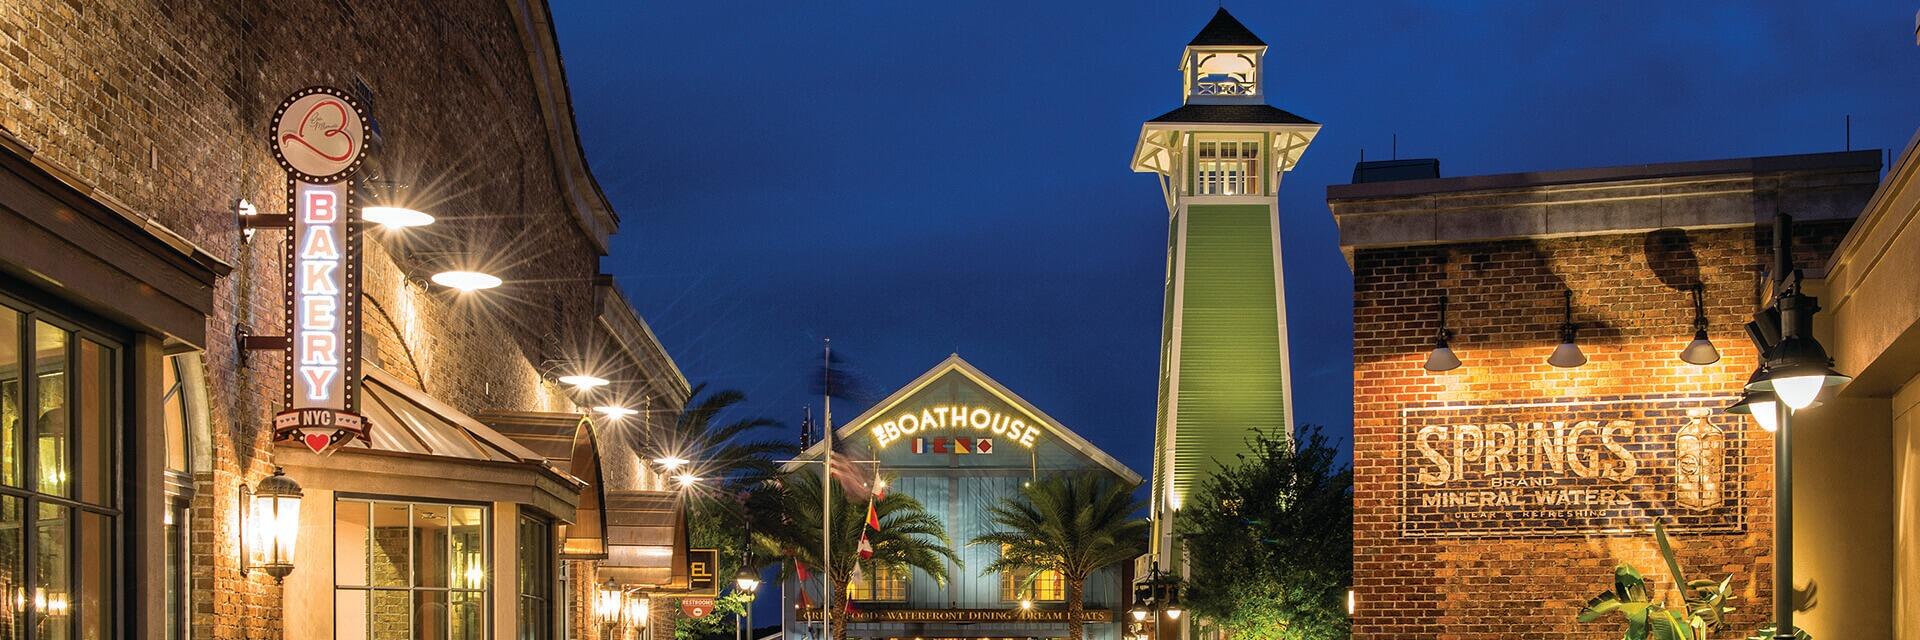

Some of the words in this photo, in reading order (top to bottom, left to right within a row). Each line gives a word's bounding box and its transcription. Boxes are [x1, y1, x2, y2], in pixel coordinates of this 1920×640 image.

[301, 190, 339, 400] BAKERY
[303, 410, 331, 426] NYC
[882, 405, 1041, 449] BOATHOUSE
[1415, 420, 1637, 486] SPRINGS
[1491, 477, 1557, 487] BRAND
[1422, 490, 1526, 508] MINERAL
[1535, 489, 1633, 506] WATERS
[1522, 510, 1608, 518] REFRESHING
[887, 612, 966, 620] WATERFRONT
[969, 612, 1011, 620] DINING
[1021, 612, 1062, 620] DREAM
